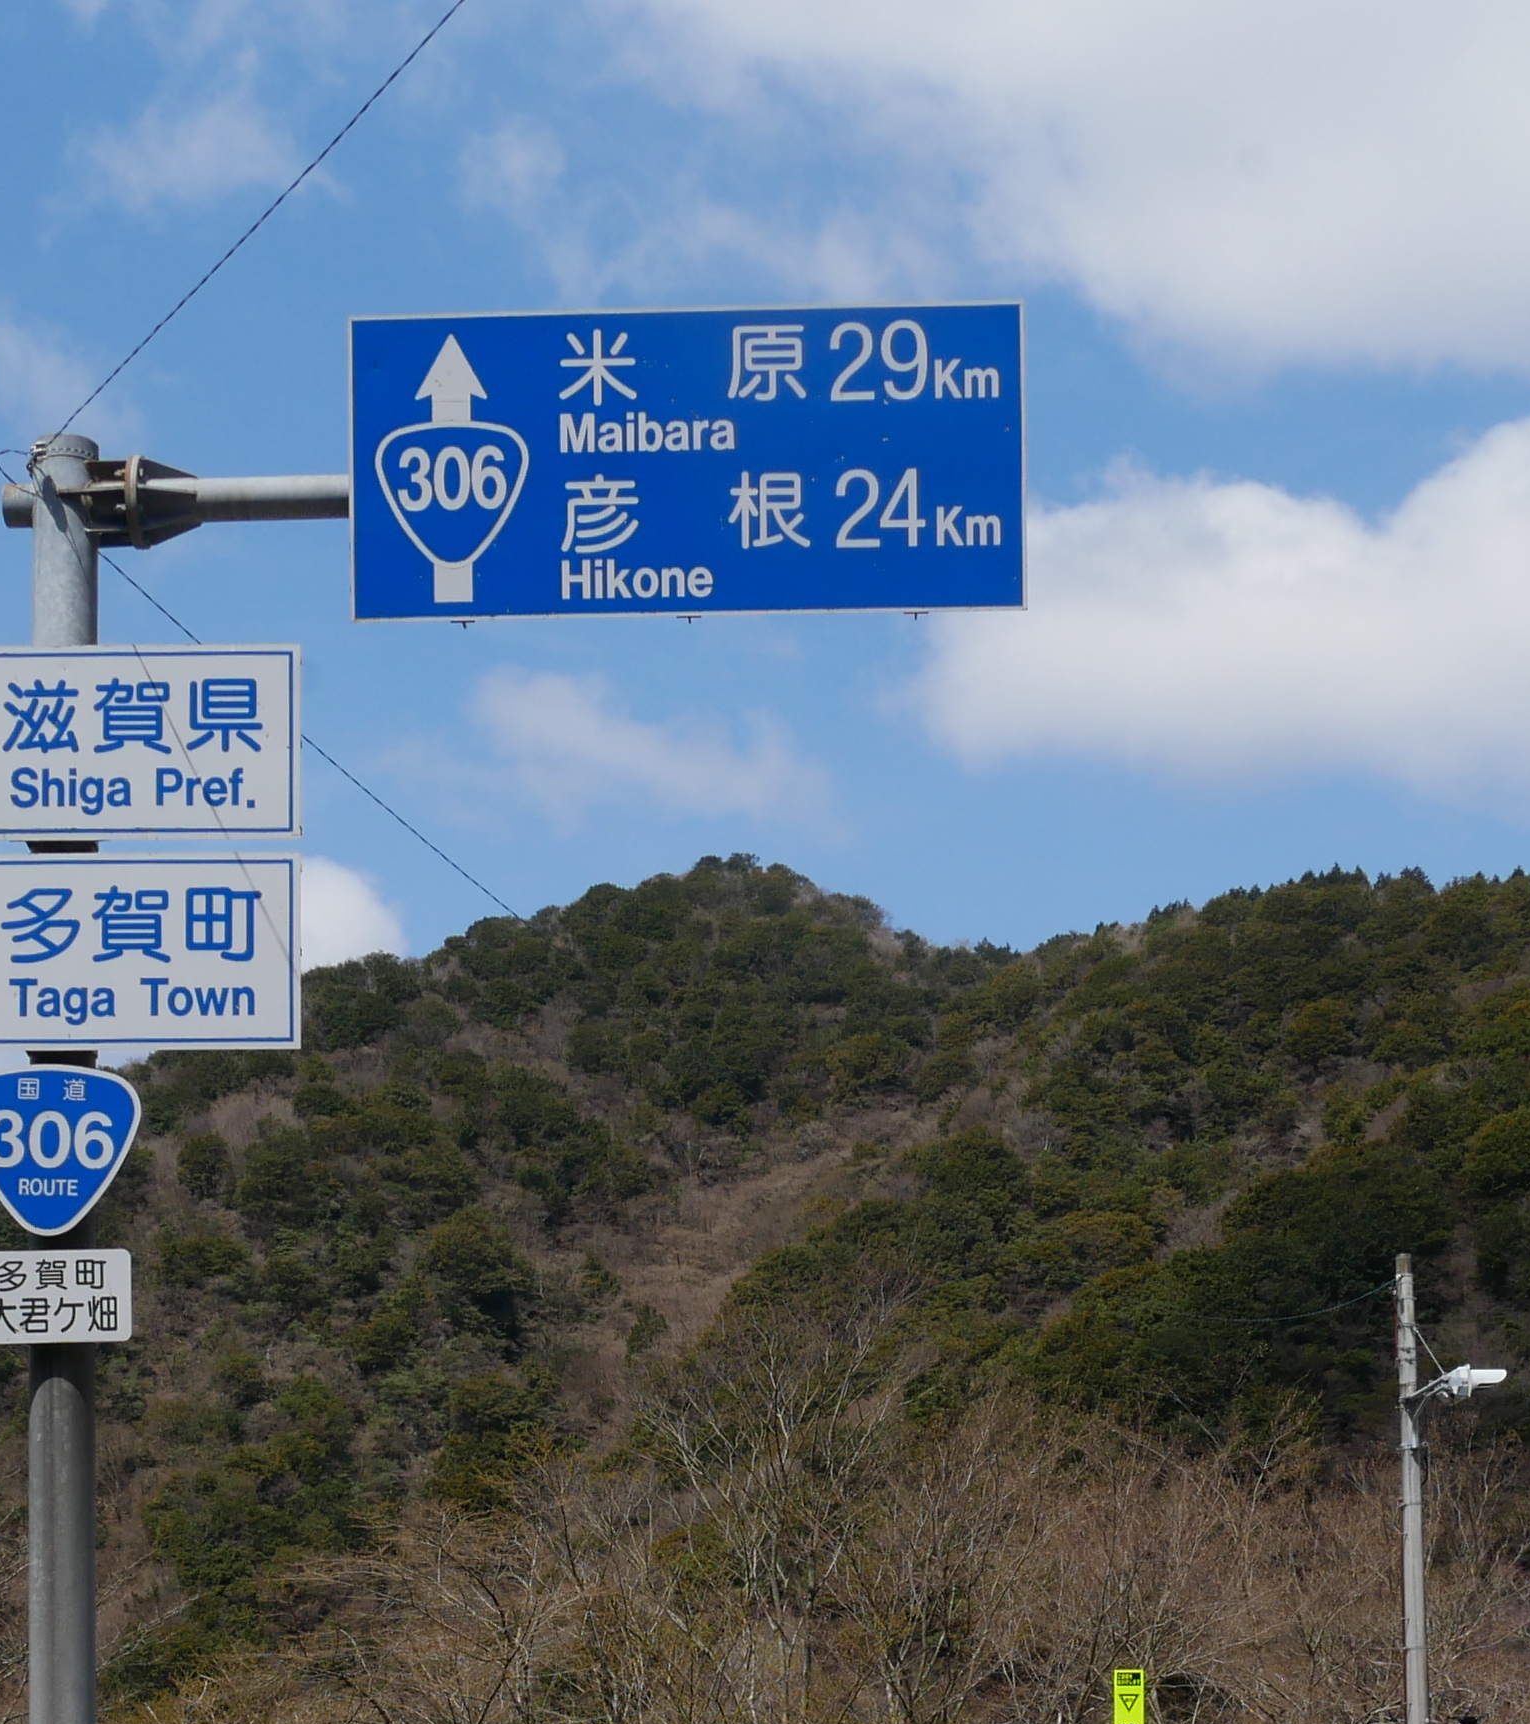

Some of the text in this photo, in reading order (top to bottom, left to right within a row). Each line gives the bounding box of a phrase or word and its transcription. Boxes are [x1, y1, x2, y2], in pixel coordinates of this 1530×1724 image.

[560, 413, 735, 453] Maibara
[398, 445, 507, 512] 306
[561, 559, 714, 600] Hikone
[2, 678, 263, 754] 滋賀県
[10, 767, 255, 815] Shiga Pref.
[1, 886, 262, 963] 多賀町
[9, 978, 255, 1025] Taga Town
[18, 1177, 79, 1197] ROUTE
